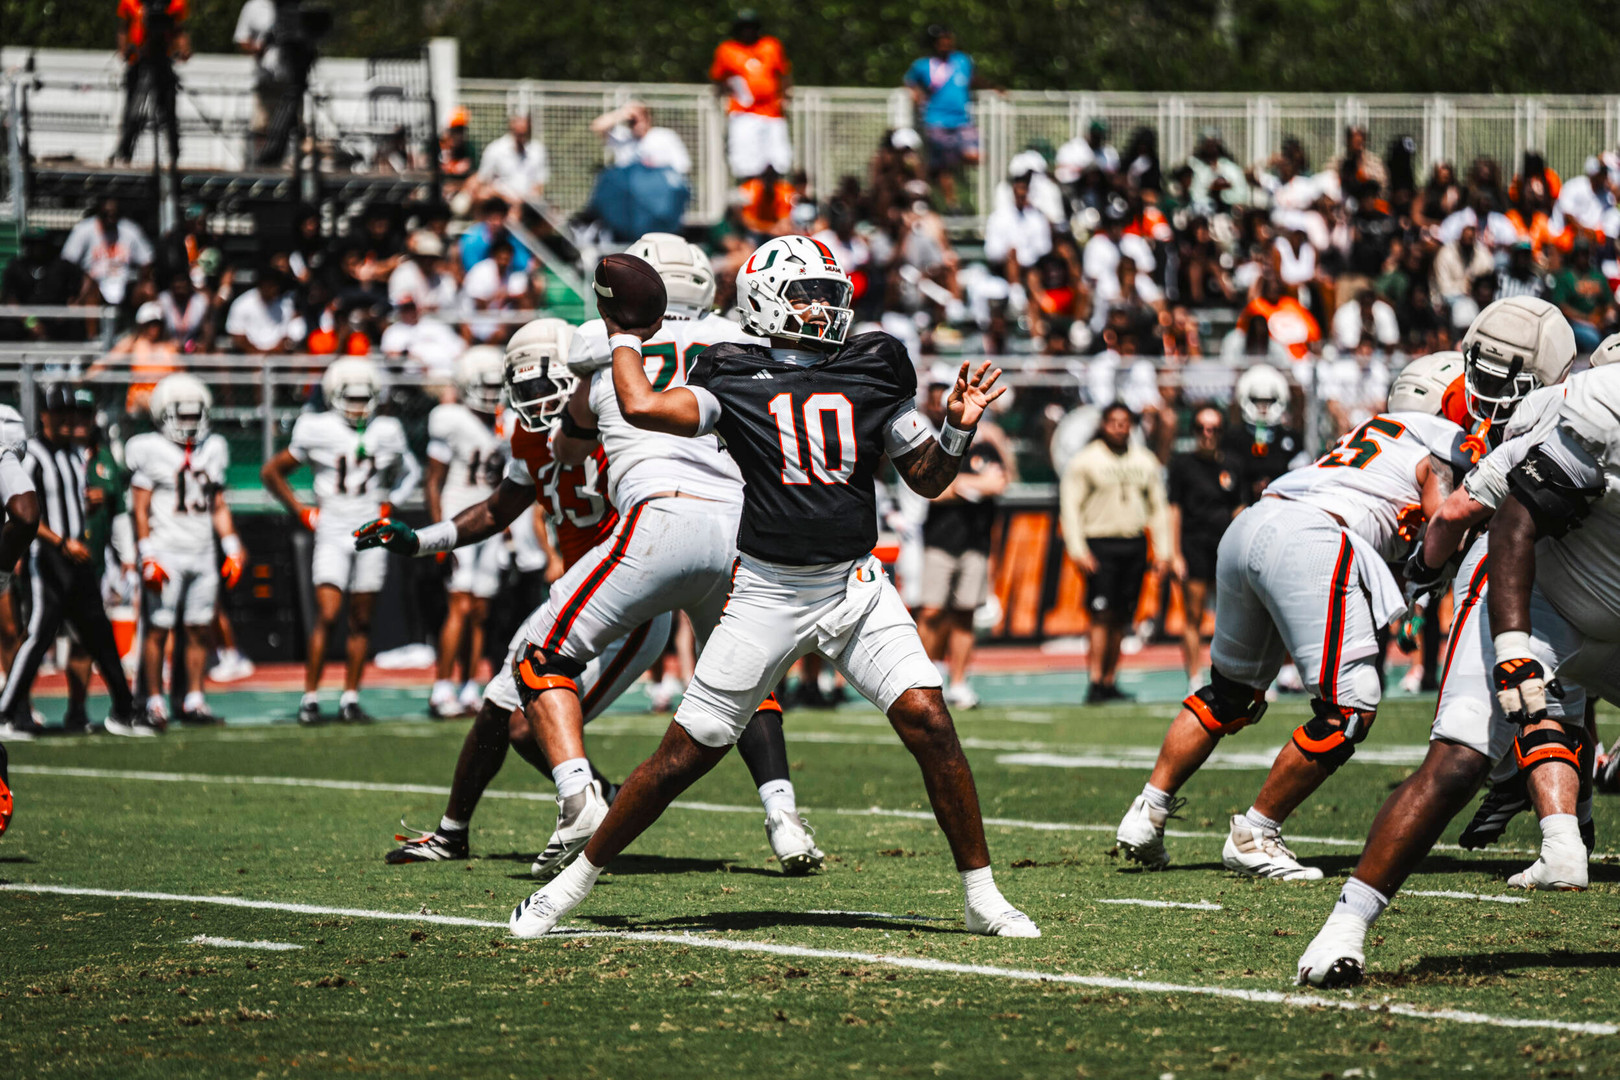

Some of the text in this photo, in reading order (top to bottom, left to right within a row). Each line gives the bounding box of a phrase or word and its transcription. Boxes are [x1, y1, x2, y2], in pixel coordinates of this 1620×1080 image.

[824, 265, 841, 274] MIAMI
[768, 392, 857, 485] 10
[1315, 416, 1406, 470] 5
[337, 454, 378, 495] 17
[538, 455, 606, 528] 33
